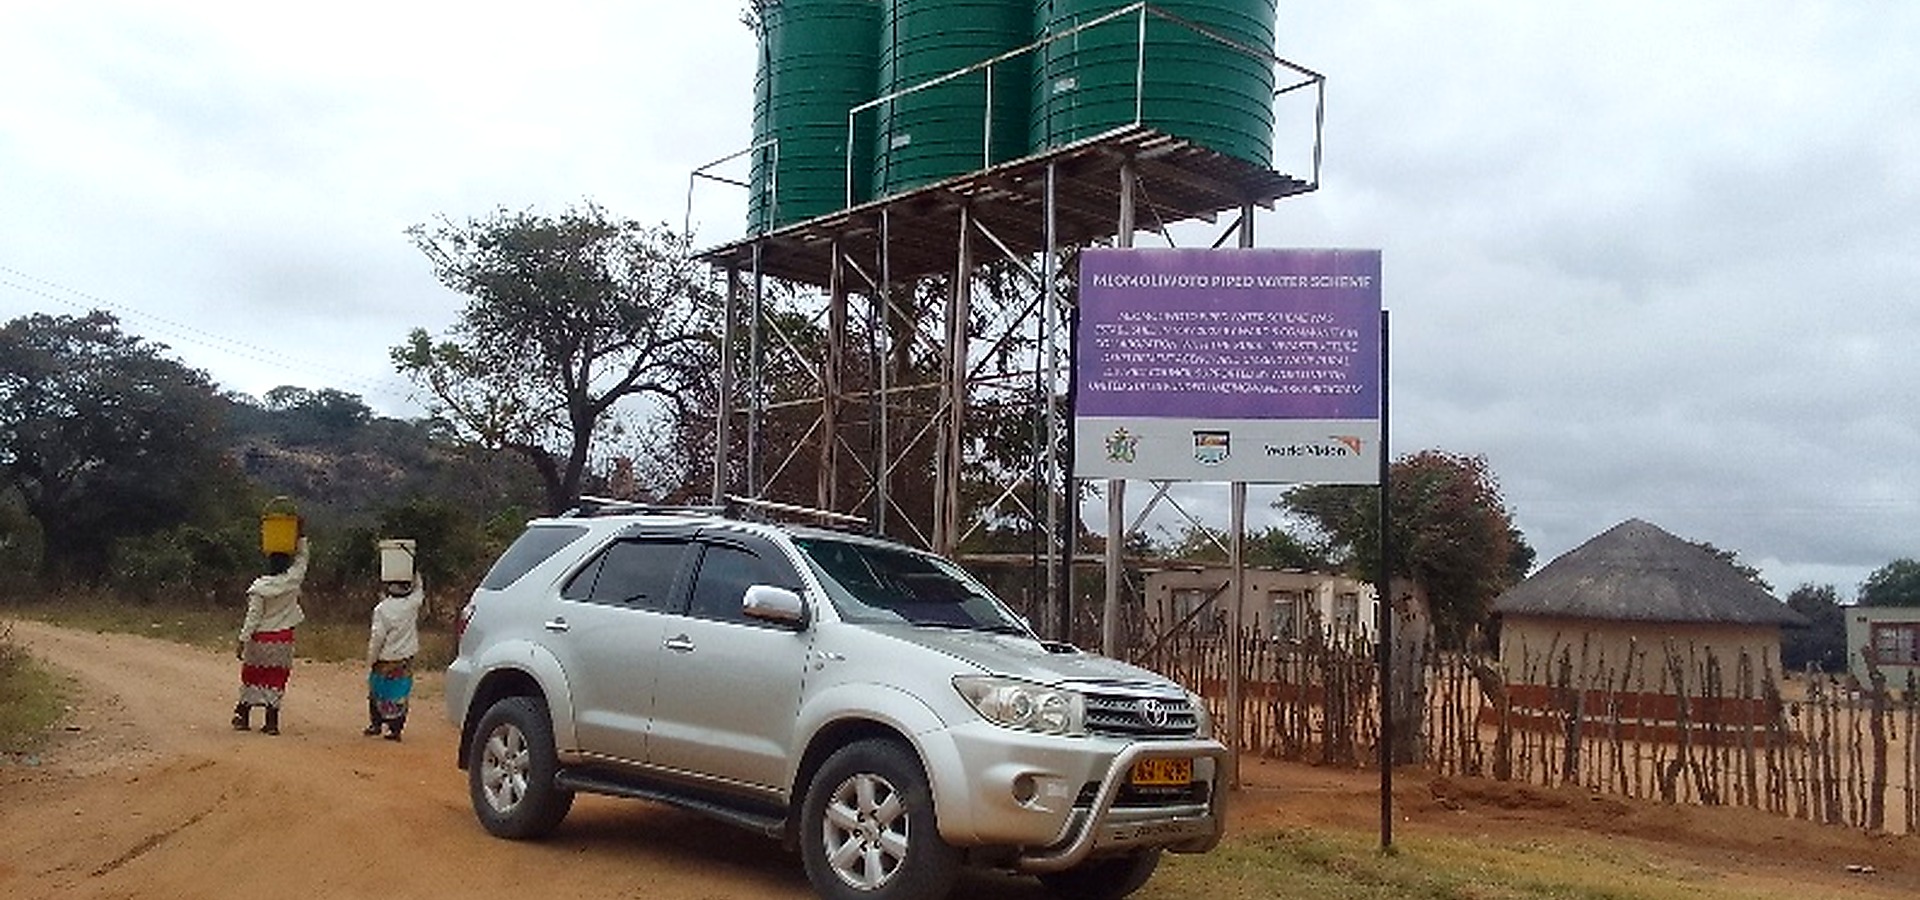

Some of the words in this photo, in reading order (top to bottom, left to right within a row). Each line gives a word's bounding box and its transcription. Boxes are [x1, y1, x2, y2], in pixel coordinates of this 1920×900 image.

[1211, 275, 1255, 288] PIPED
[1257, 275, 1308, 288] WATER
[1310, 275, 1372, 289] SCHEME
[1264, 444, 1304, 456] World
[1305, 444, 1347, 456] Vision
